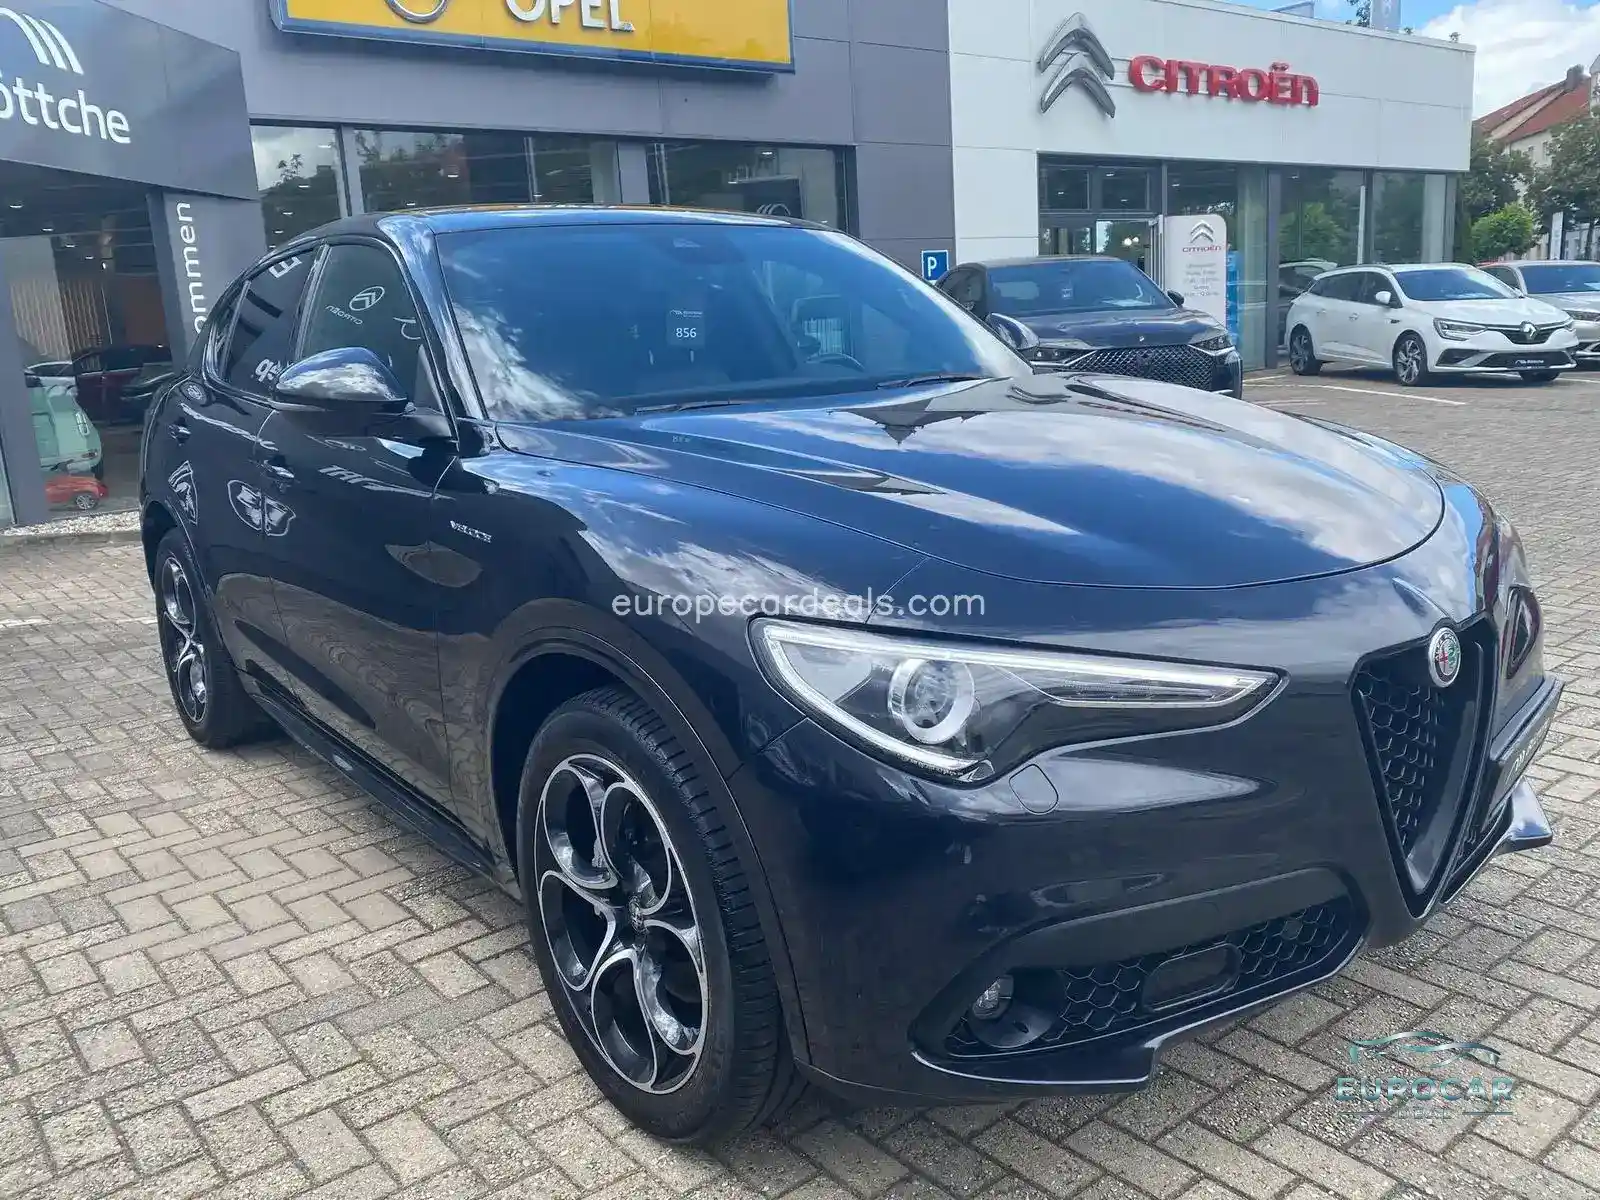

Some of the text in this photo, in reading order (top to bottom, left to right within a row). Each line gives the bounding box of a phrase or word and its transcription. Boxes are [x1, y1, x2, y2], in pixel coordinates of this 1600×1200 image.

[1128, 55, 1320, 107] CITROËN
[927, 256, 938, 277] P
[675, 327, 697, 338] 856
